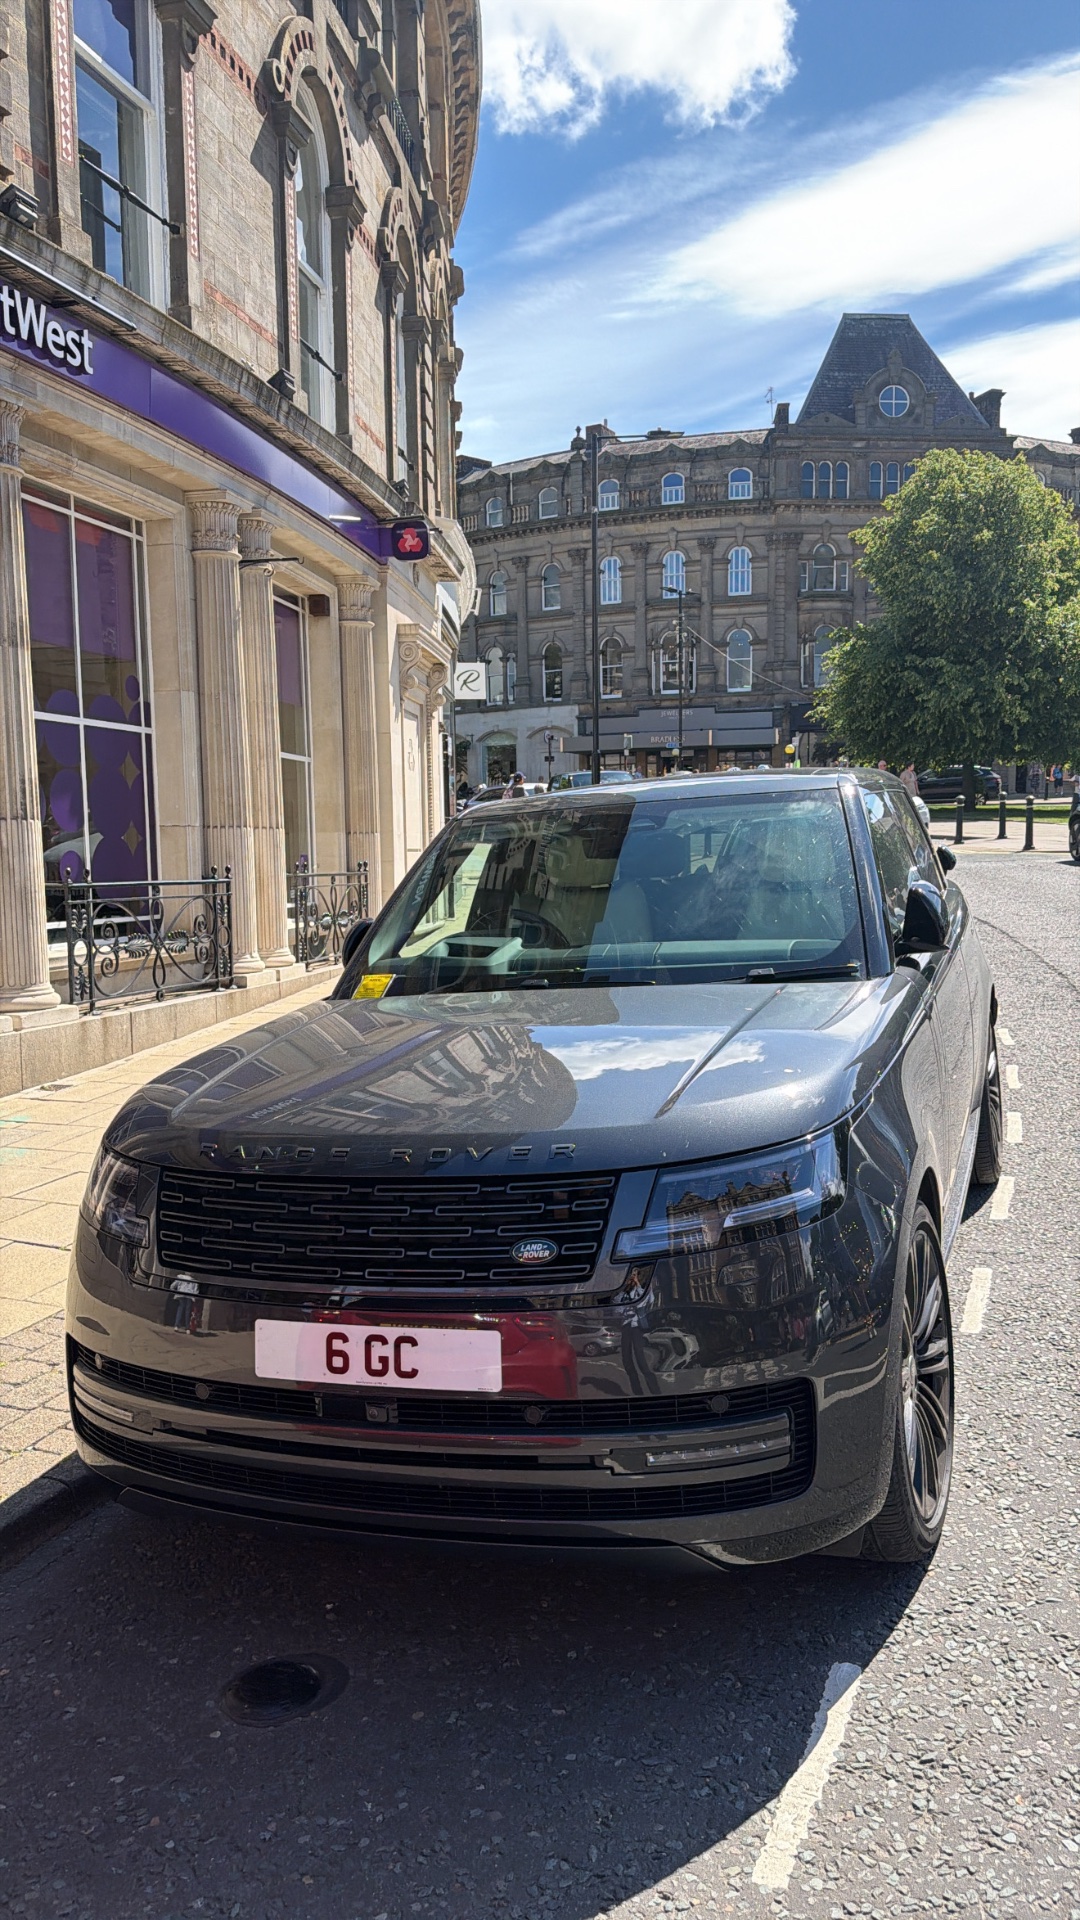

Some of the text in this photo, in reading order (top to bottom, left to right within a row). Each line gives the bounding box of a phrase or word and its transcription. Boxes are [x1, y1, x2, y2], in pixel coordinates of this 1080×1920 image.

[456, 669, 481, 692] R
[199, 1142, 576, 1163] RANGE ROVER
[325, 1332, 419, 1379] 6 GC
